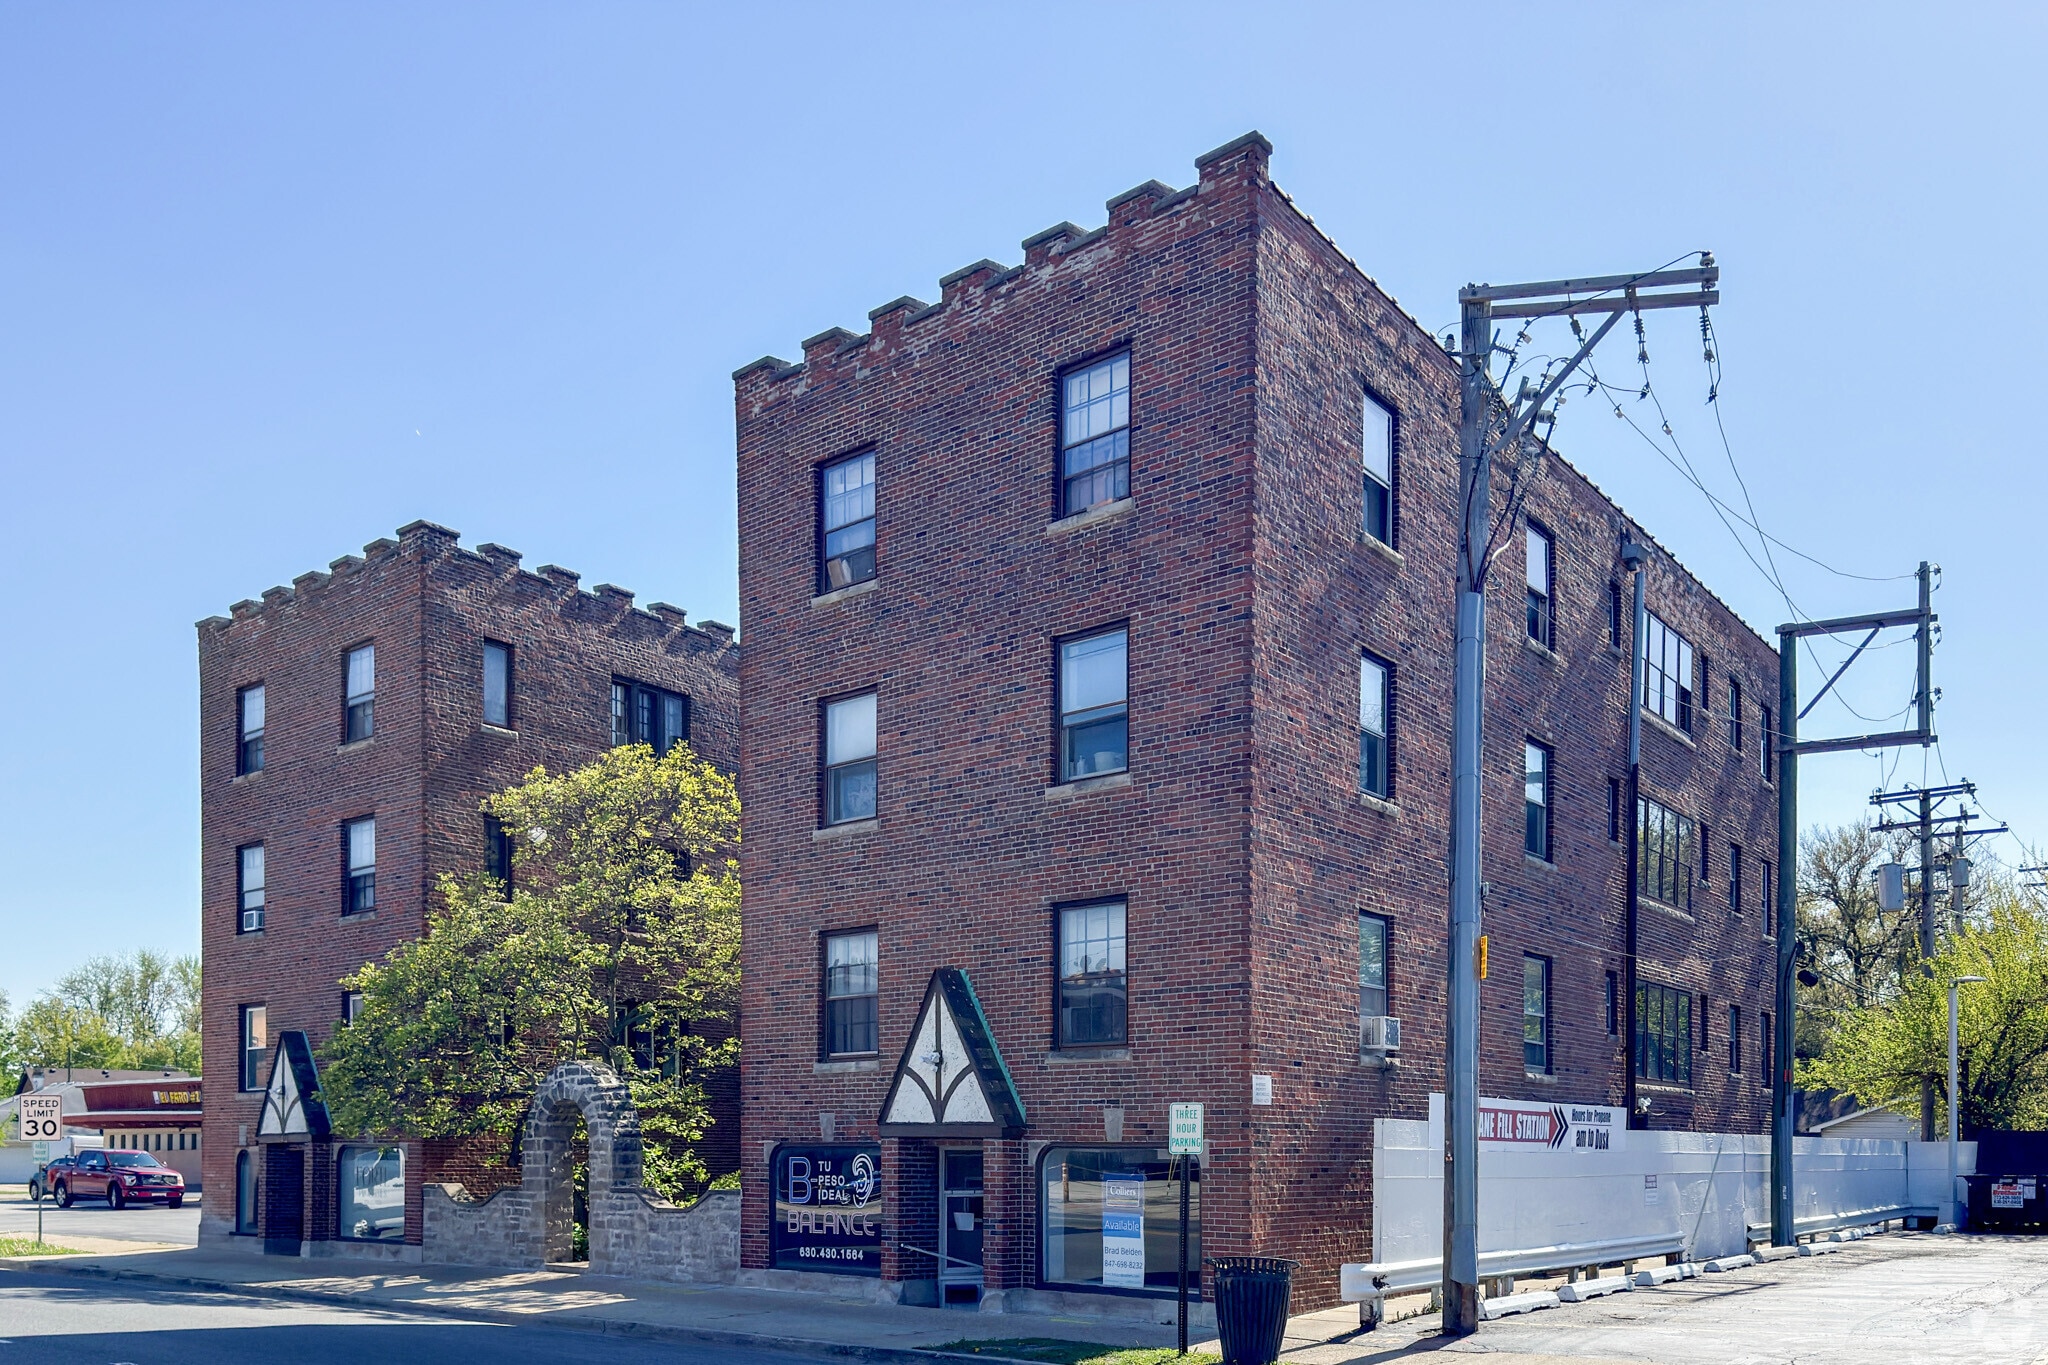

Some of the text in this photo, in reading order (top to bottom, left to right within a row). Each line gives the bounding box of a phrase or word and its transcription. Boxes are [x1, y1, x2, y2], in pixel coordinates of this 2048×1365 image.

[23, 1099, 59, 1108] SPEED
[27, 1109, 54, 1118] LIMIT
[1176, 1109, 1198, 1120] THREE
[1571, 1108, 1586, 1122] Hours
[1594, 1110, 1612, 1123] Propane
[25, 1119, 57, 1136] 30
[1176, 1123, 1197, 1134] HOUR
[1497, 1111, 1513, 1139] FILL
[1515, 1113, 1551, 1140] STATION
[1172, 1138, 1201, 1148] PARKING
[1576, 1129, 1609, 1150] am to Dusk
[818, 1160, 832, 1172] TU
[818, 1175, 845, 1187] PESO
[818, 1189, 848, 1201] IDEAL
[1109, 1185, 1137, 1196] Colliers
[787, 1210, 876, 1237] BALANCE
[1104, 1219, 1140, 1232] Available
[1104, 1246, 1143, 1256] Brad Belden
